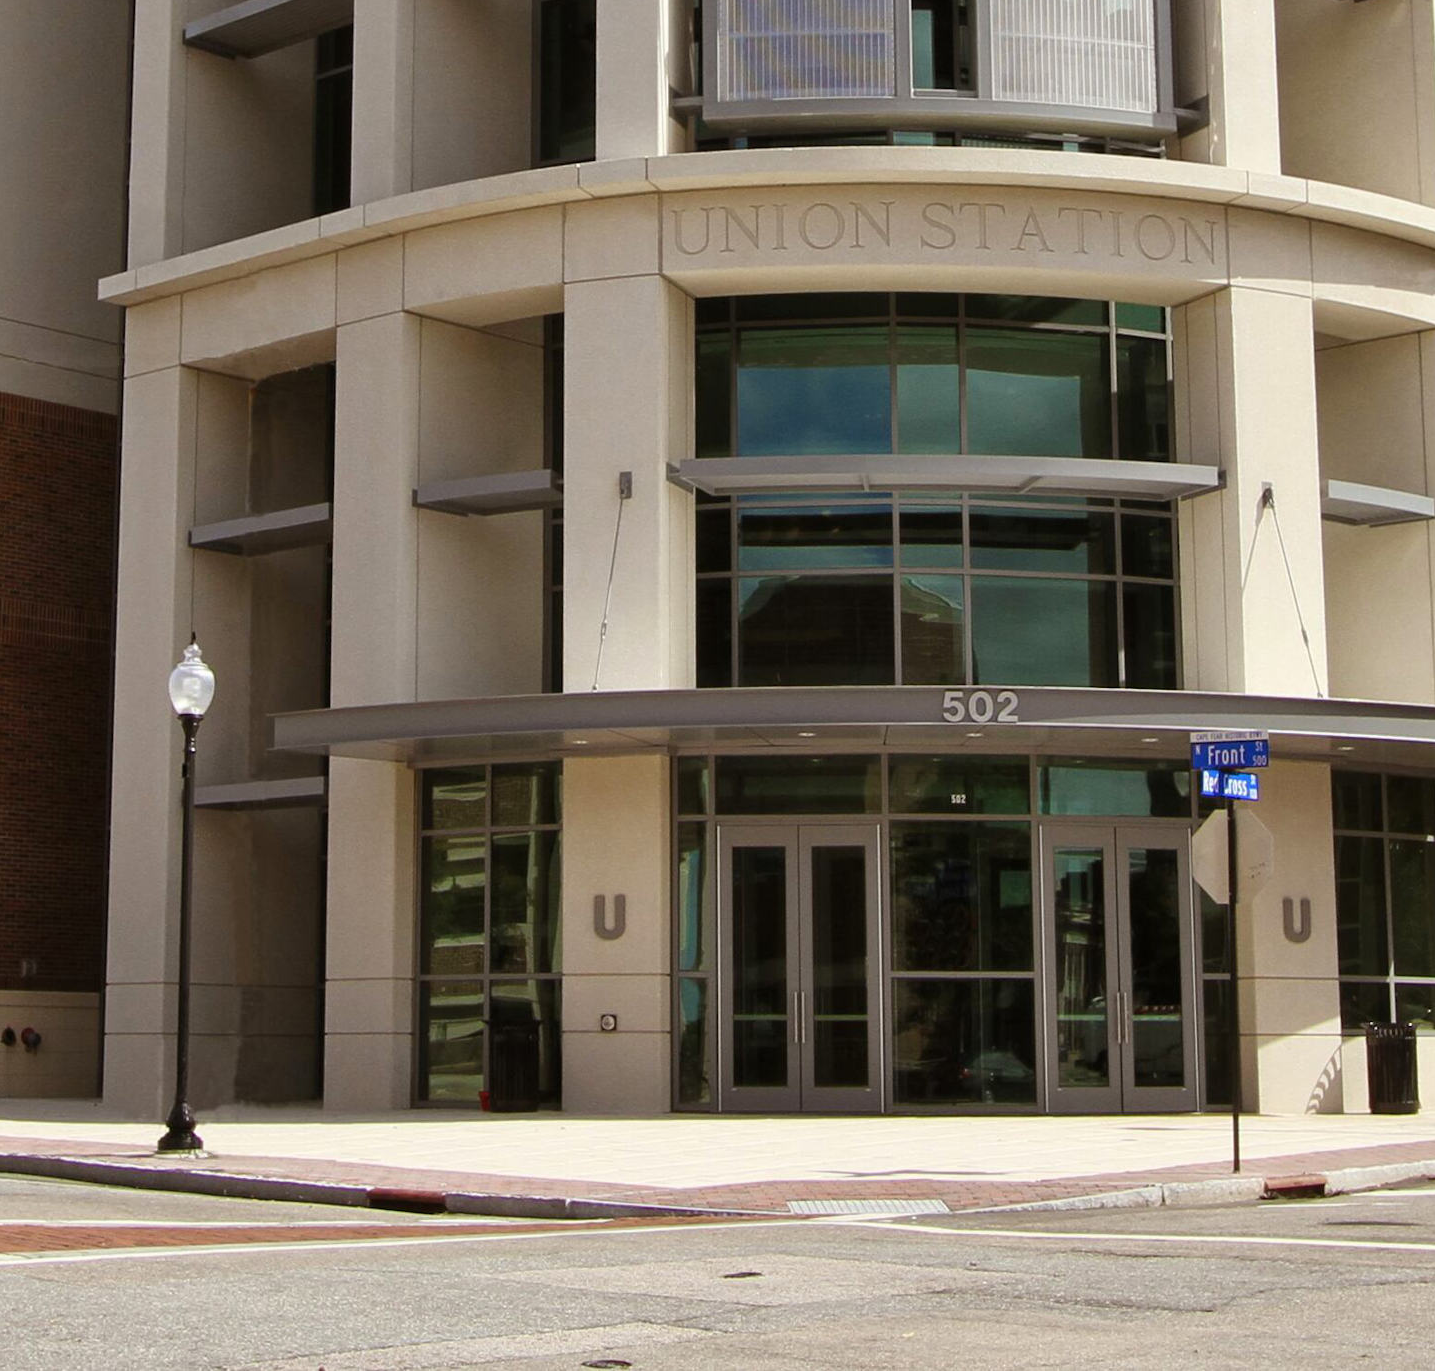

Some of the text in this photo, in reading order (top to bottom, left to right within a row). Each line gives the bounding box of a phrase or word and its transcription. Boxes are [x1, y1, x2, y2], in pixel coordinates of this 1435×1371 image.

[672, 200, 1217, 265] UNION STATION
[942, 690, 1019, 724] 502
[1195, 745, 1201, 755] N
[1208, 745, 1245, 765] Front
[951, 794, 966, 804] 502
[1202, 770, 1220, 793] Red
[1224, 774, 1248, 796] Cross
[593, 894, 626, 940] U
[1282, 897, 1311, 943] U
